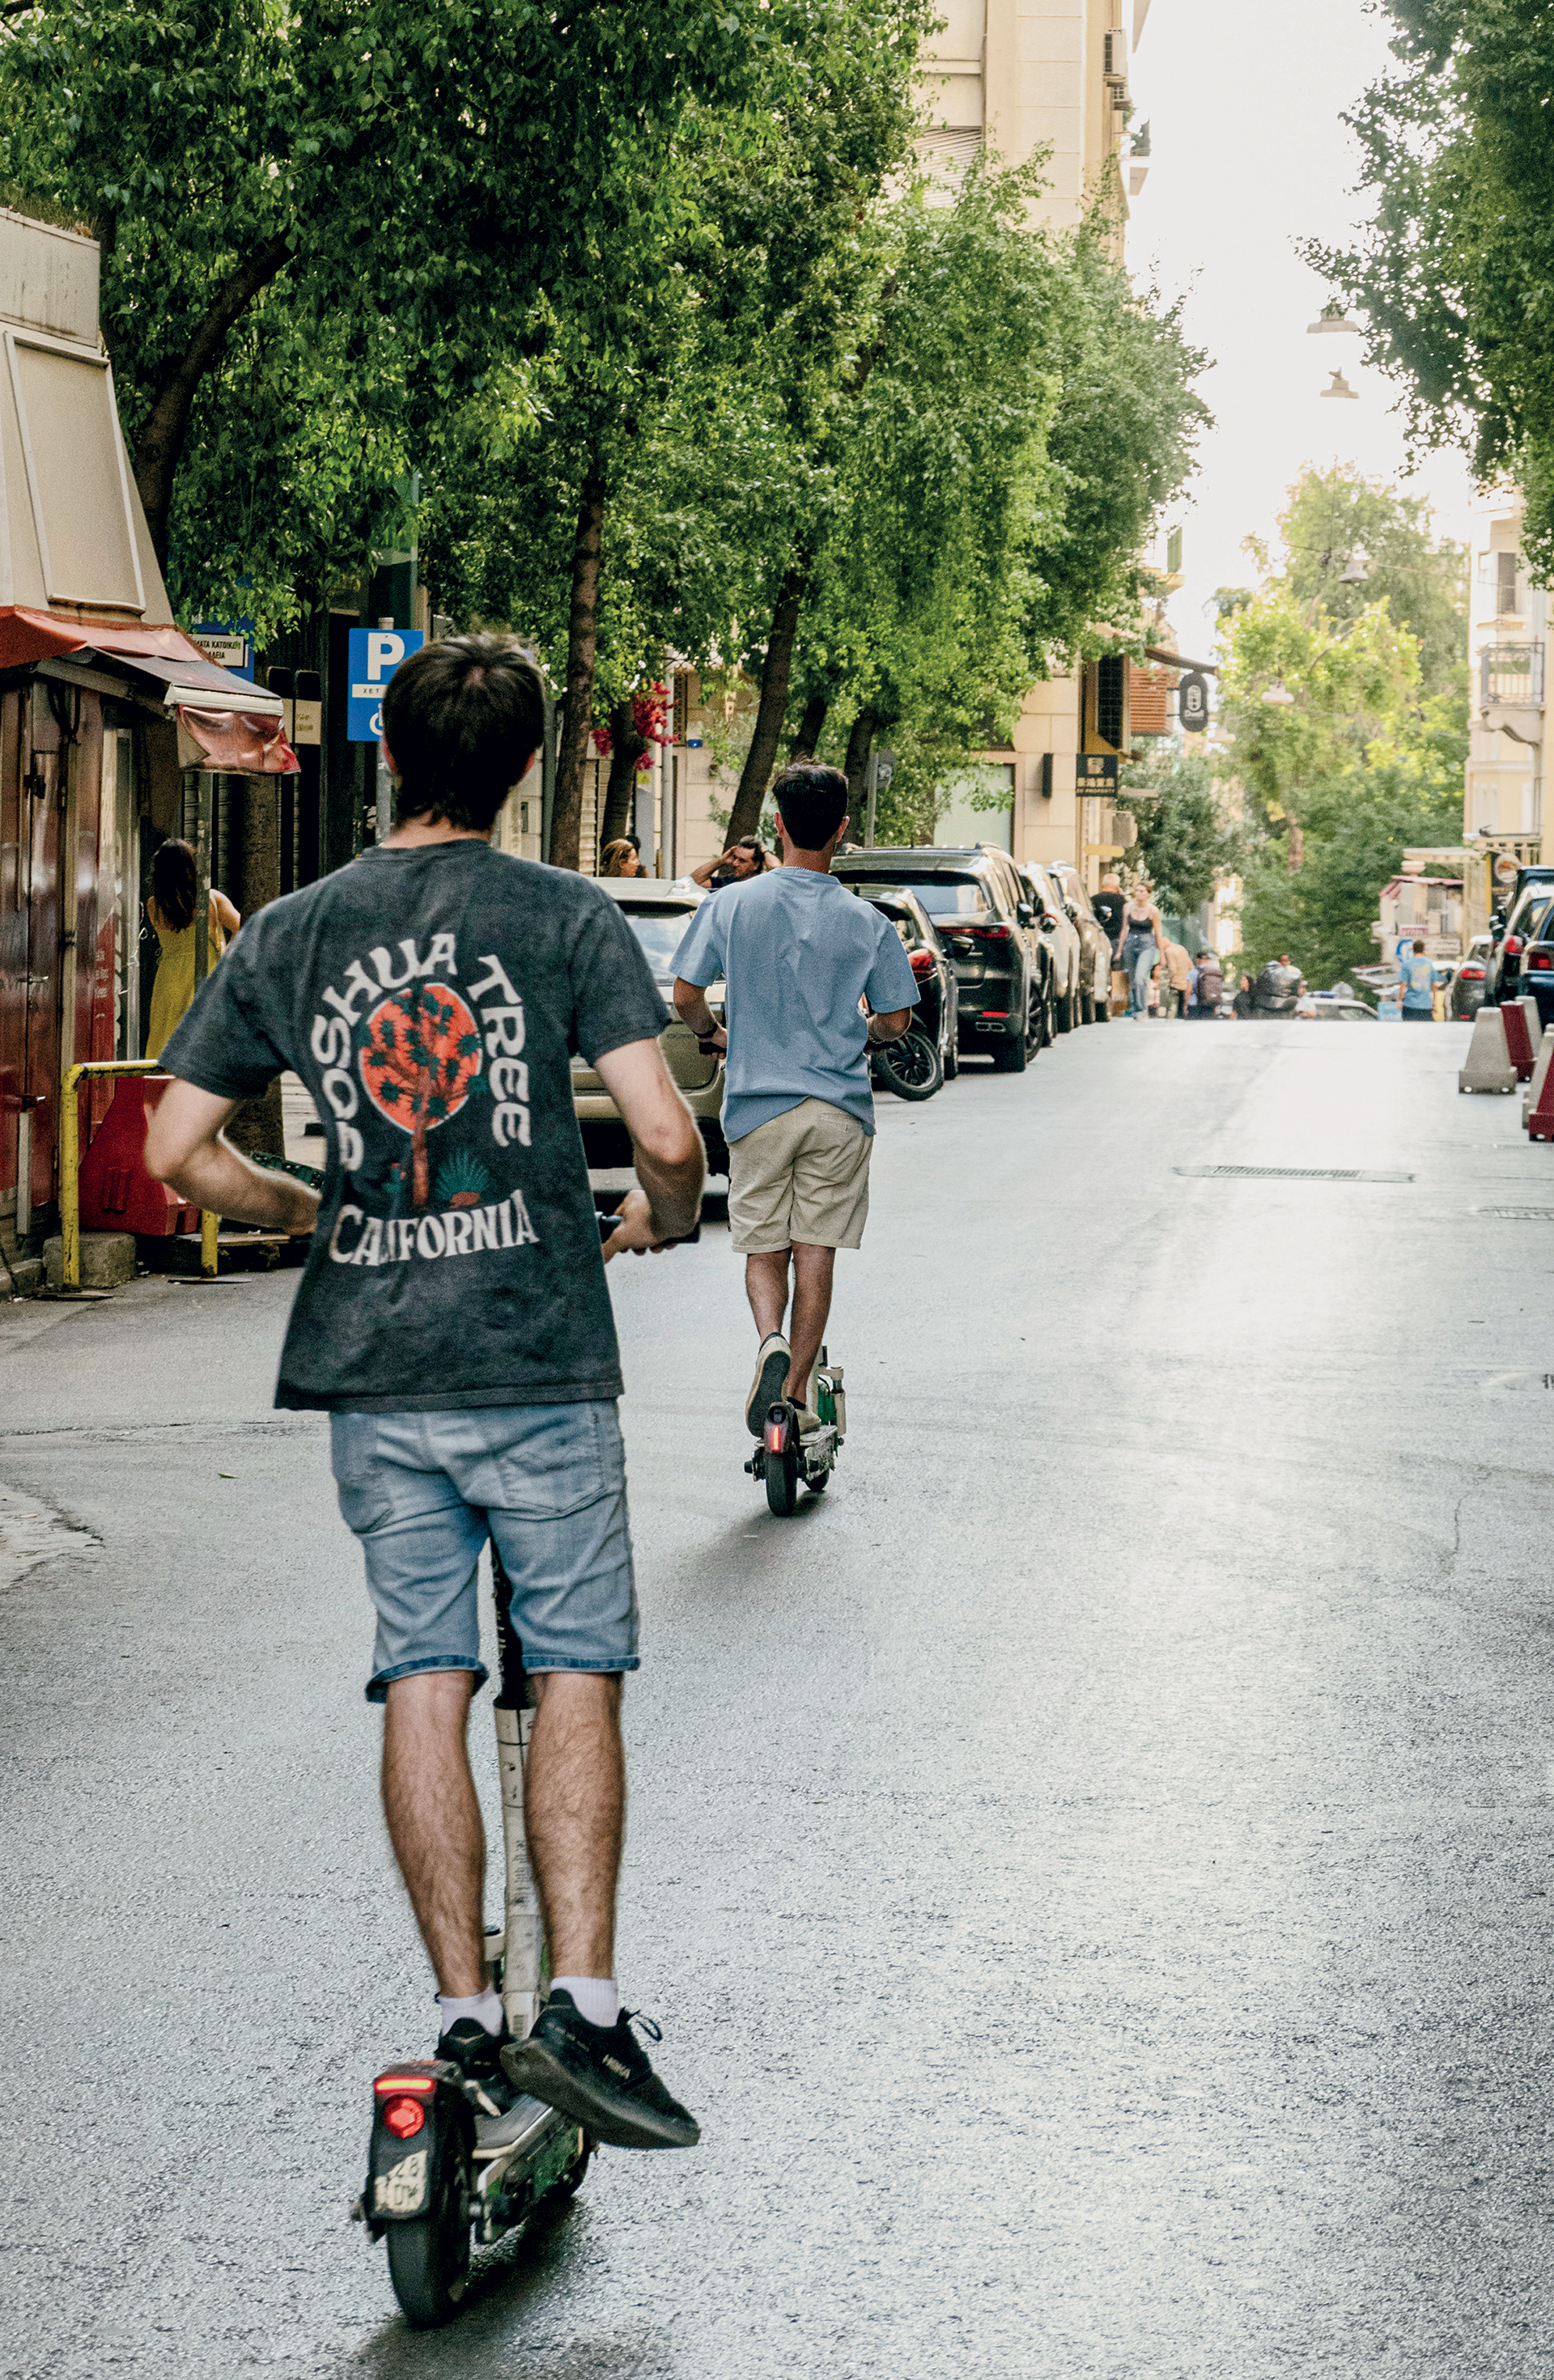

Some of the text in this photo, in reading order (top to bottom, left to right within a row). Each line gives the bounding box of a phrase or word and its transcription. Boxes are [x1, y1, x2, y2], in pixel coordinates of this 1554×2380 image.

[212, 640, 240, 650] ΚΑΤΟΙΚ
[367, 632, 405, 681] P
[467, 954, 533, 1147] TREE
